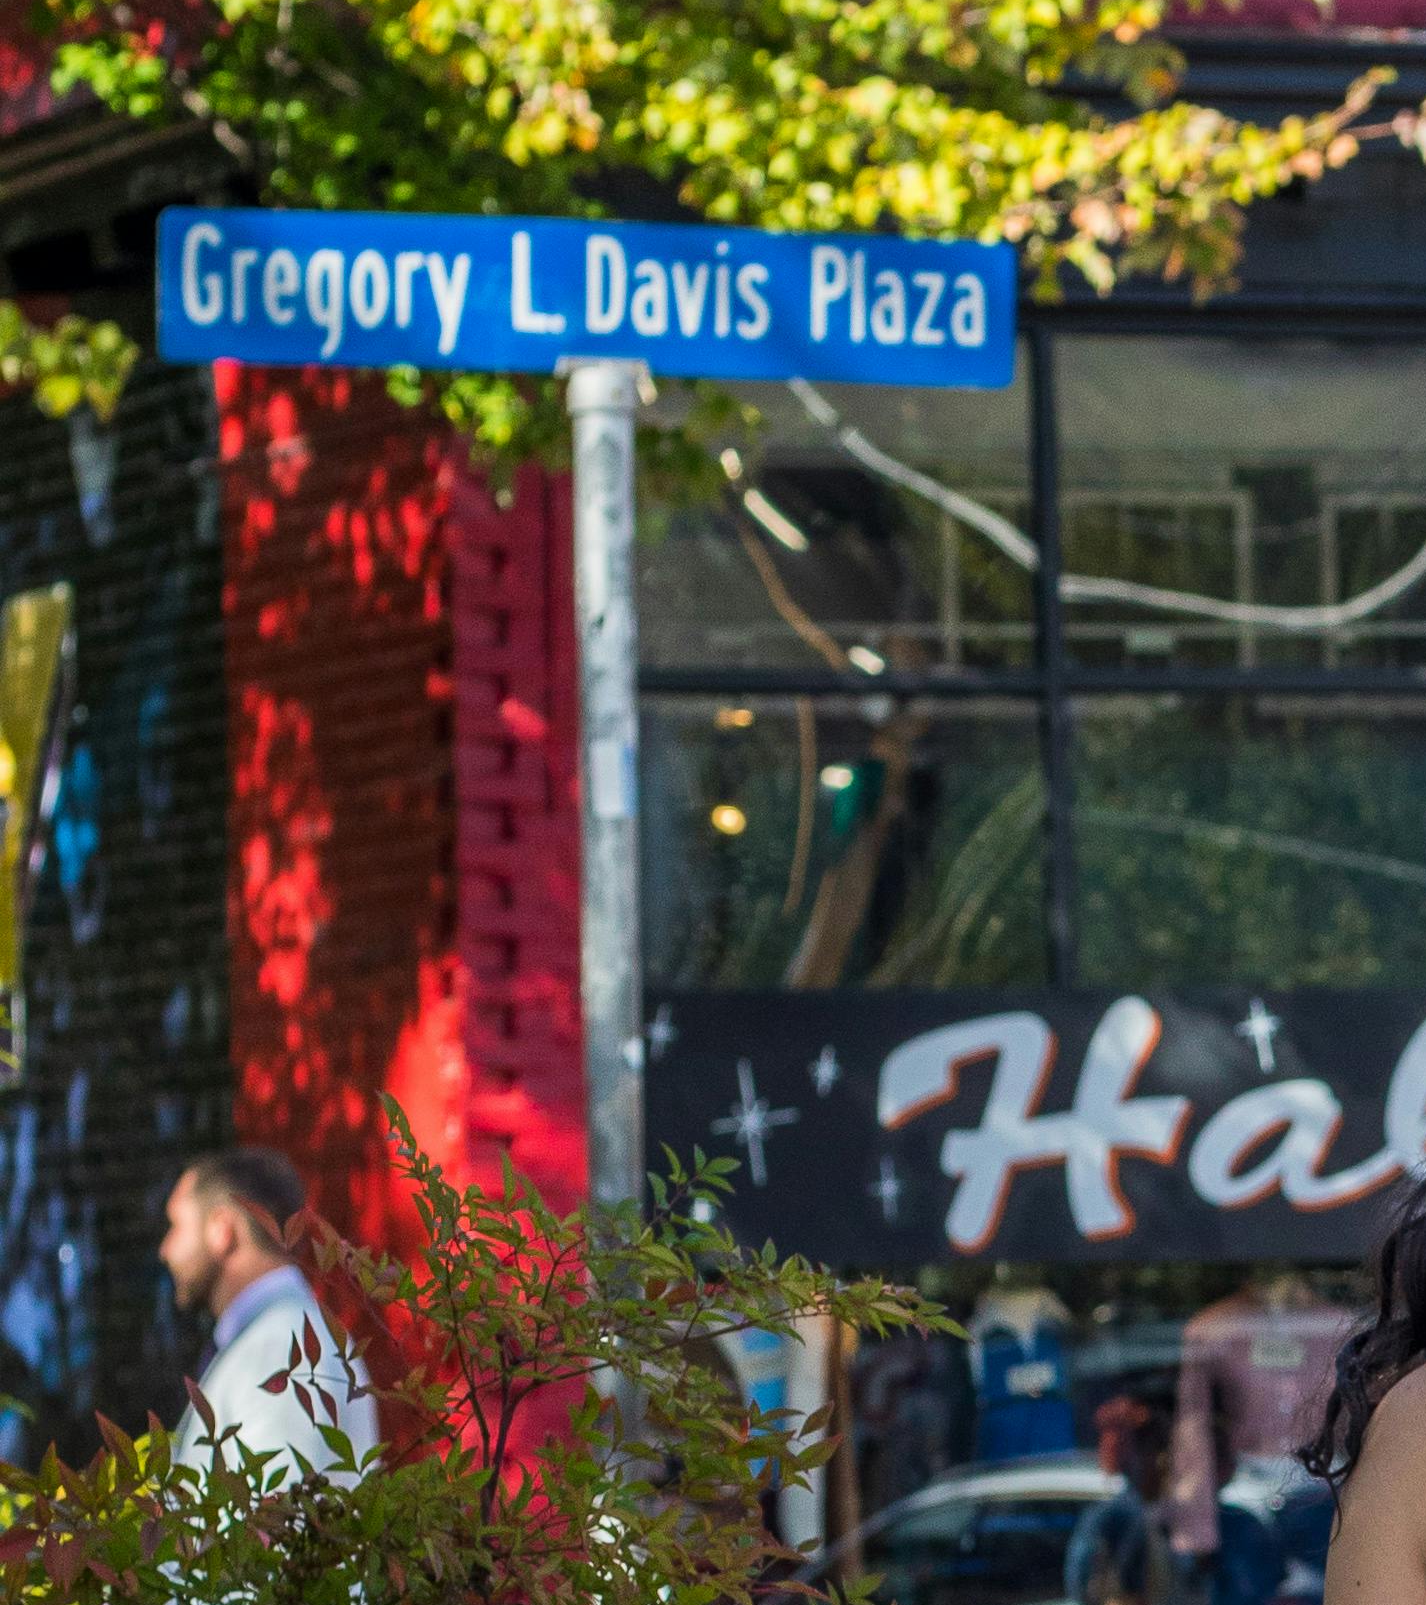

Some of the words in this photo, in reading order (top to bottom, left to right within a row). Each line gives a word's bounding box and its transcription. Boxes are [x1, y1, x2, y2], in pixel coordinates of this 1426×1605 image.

[180, 222, 471, 359] Gregory
[585, 233, 772, 341] Davis
[809, 245, 987, 348] Plaza
